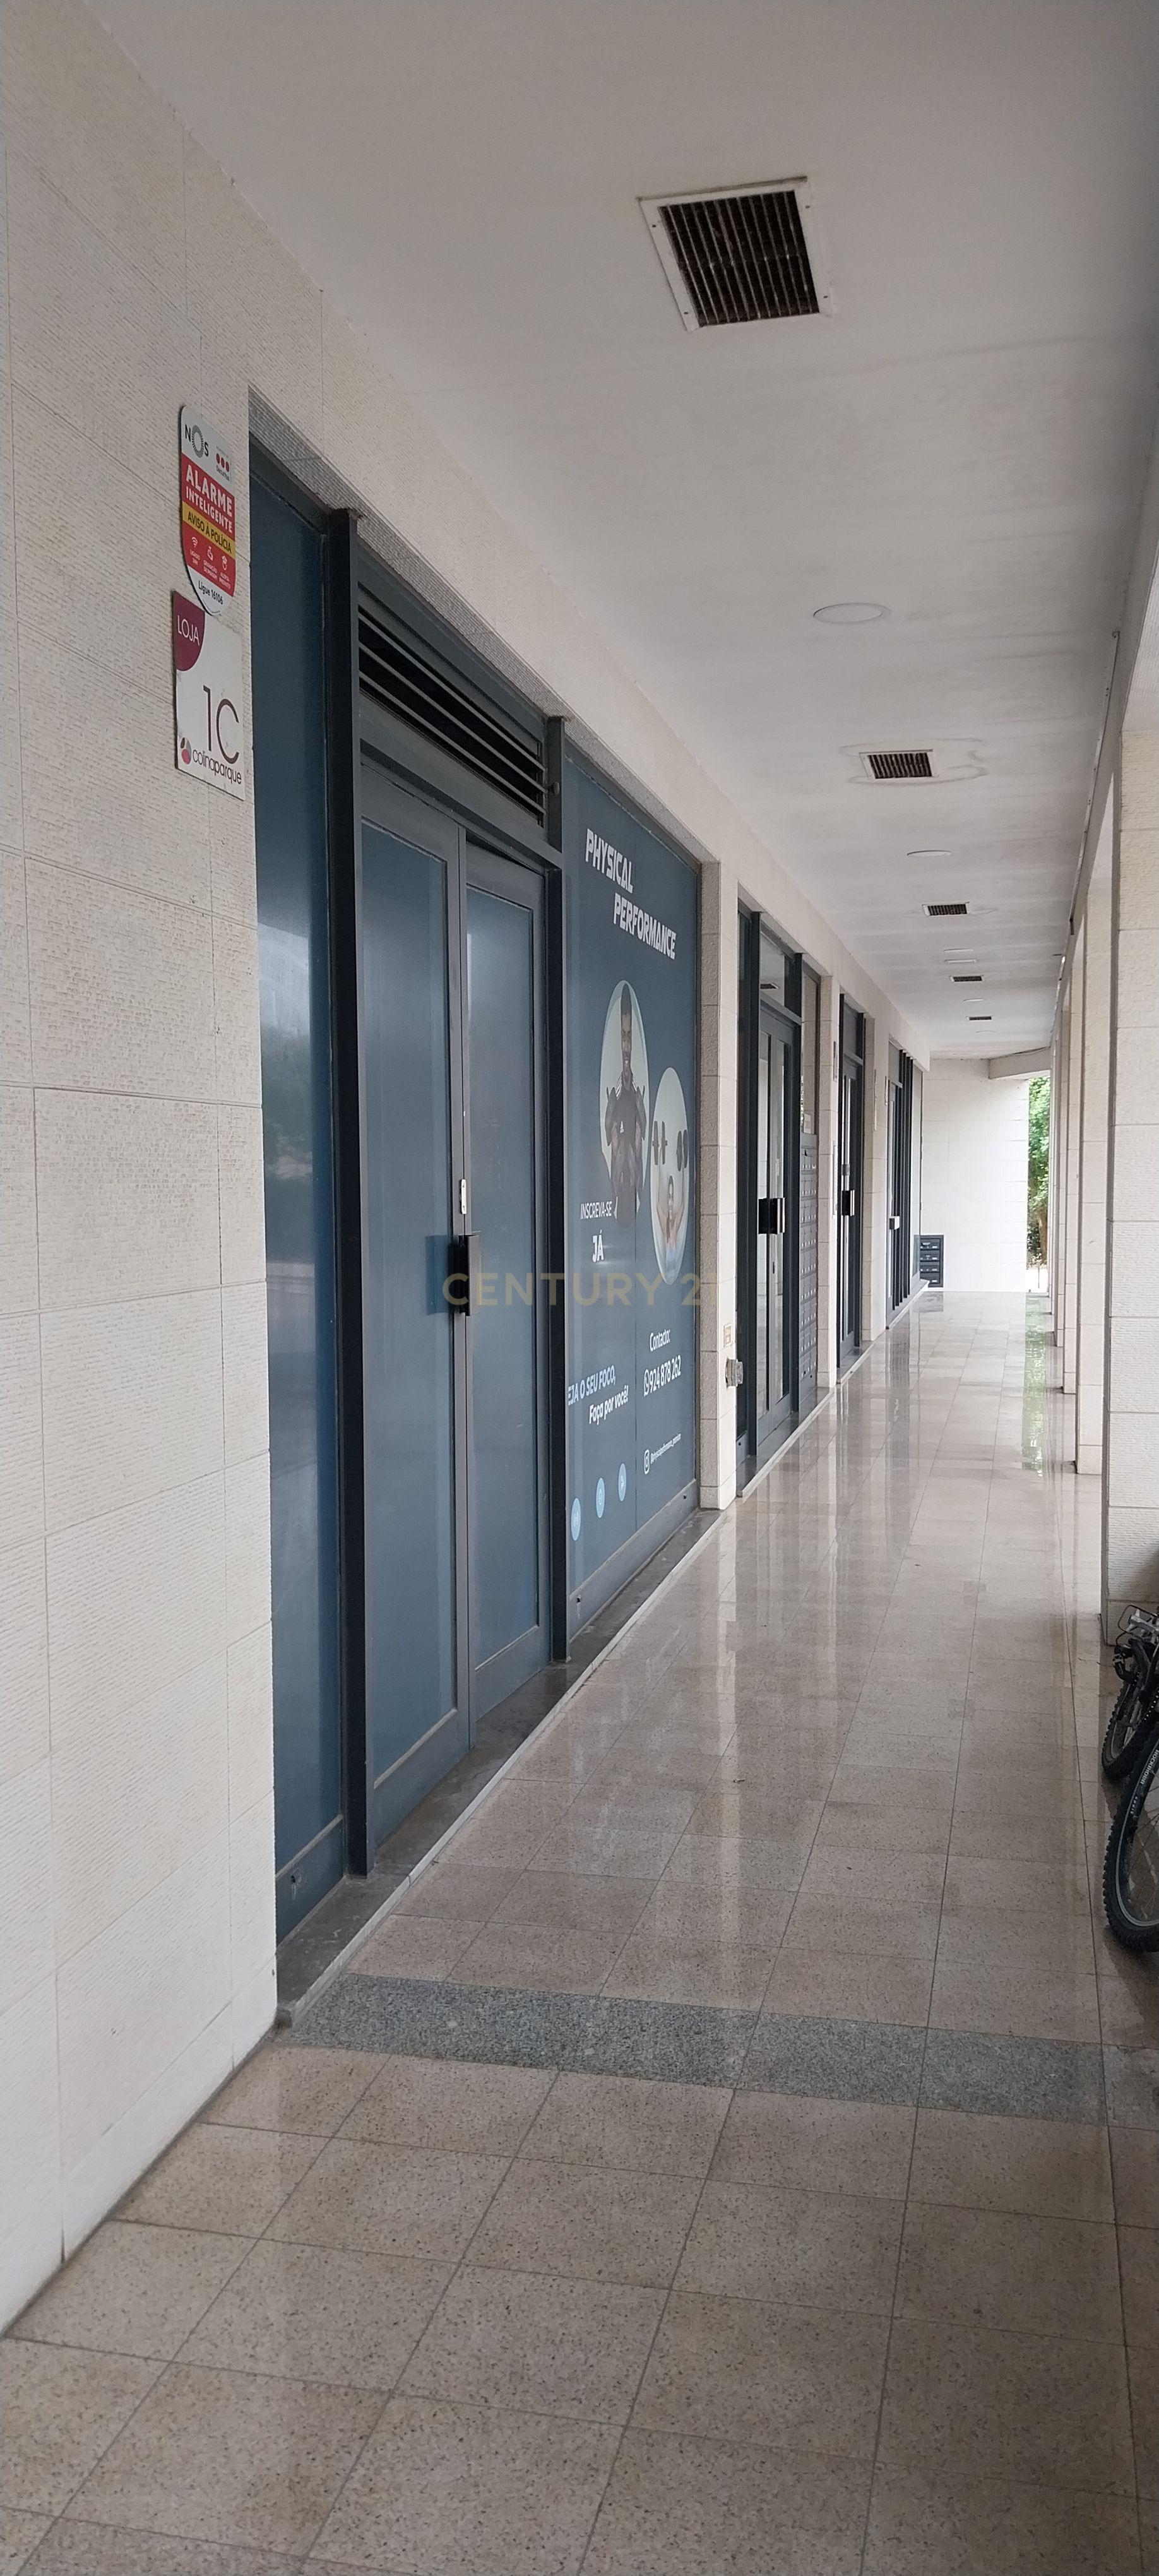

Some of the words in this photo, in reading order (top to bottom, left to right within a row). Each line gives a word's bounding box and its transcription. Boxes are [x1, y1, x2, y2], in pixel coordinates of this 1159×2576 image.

[185, 424, 209, 458] NOS
[186, 464, 233, 517] ALARME
[186, 486, 233, 534] INTELIGENTE
[188, 511, 205, 532] AVISO
[211, 529, 232, 553] POLÍCIA
[198, 580, 211, 597] Ligue
[177, 614, 200, 646] LOJA
[203, 684, 240, 765] 1C
[192, 748, 242, 785] colinaparque
[585, 828, 633, 894] PHYSICAL
[613, 892, 677, 960] PERFORMANCE
[580, 1201, 612, 1220] INSCREVA-SE
[592, 1229, 605, 1263] JÁ
[649, 1328, 671, 1352] Contacto:
[580, 1379, 585, 1399] O
[586, 1373, 598, 1397] SEU
[598, 1364, 616, 1390] FOCO,
[649, 1366, 660, 1393] 924
[660, 1360, 671, 1386] 878
[671, 1354, 681, 1380] 262
[589, 1402, 604, 1426] Faça
[603, 1396, 614, 1421] por
[614, 1385, 629, 1409] você!
